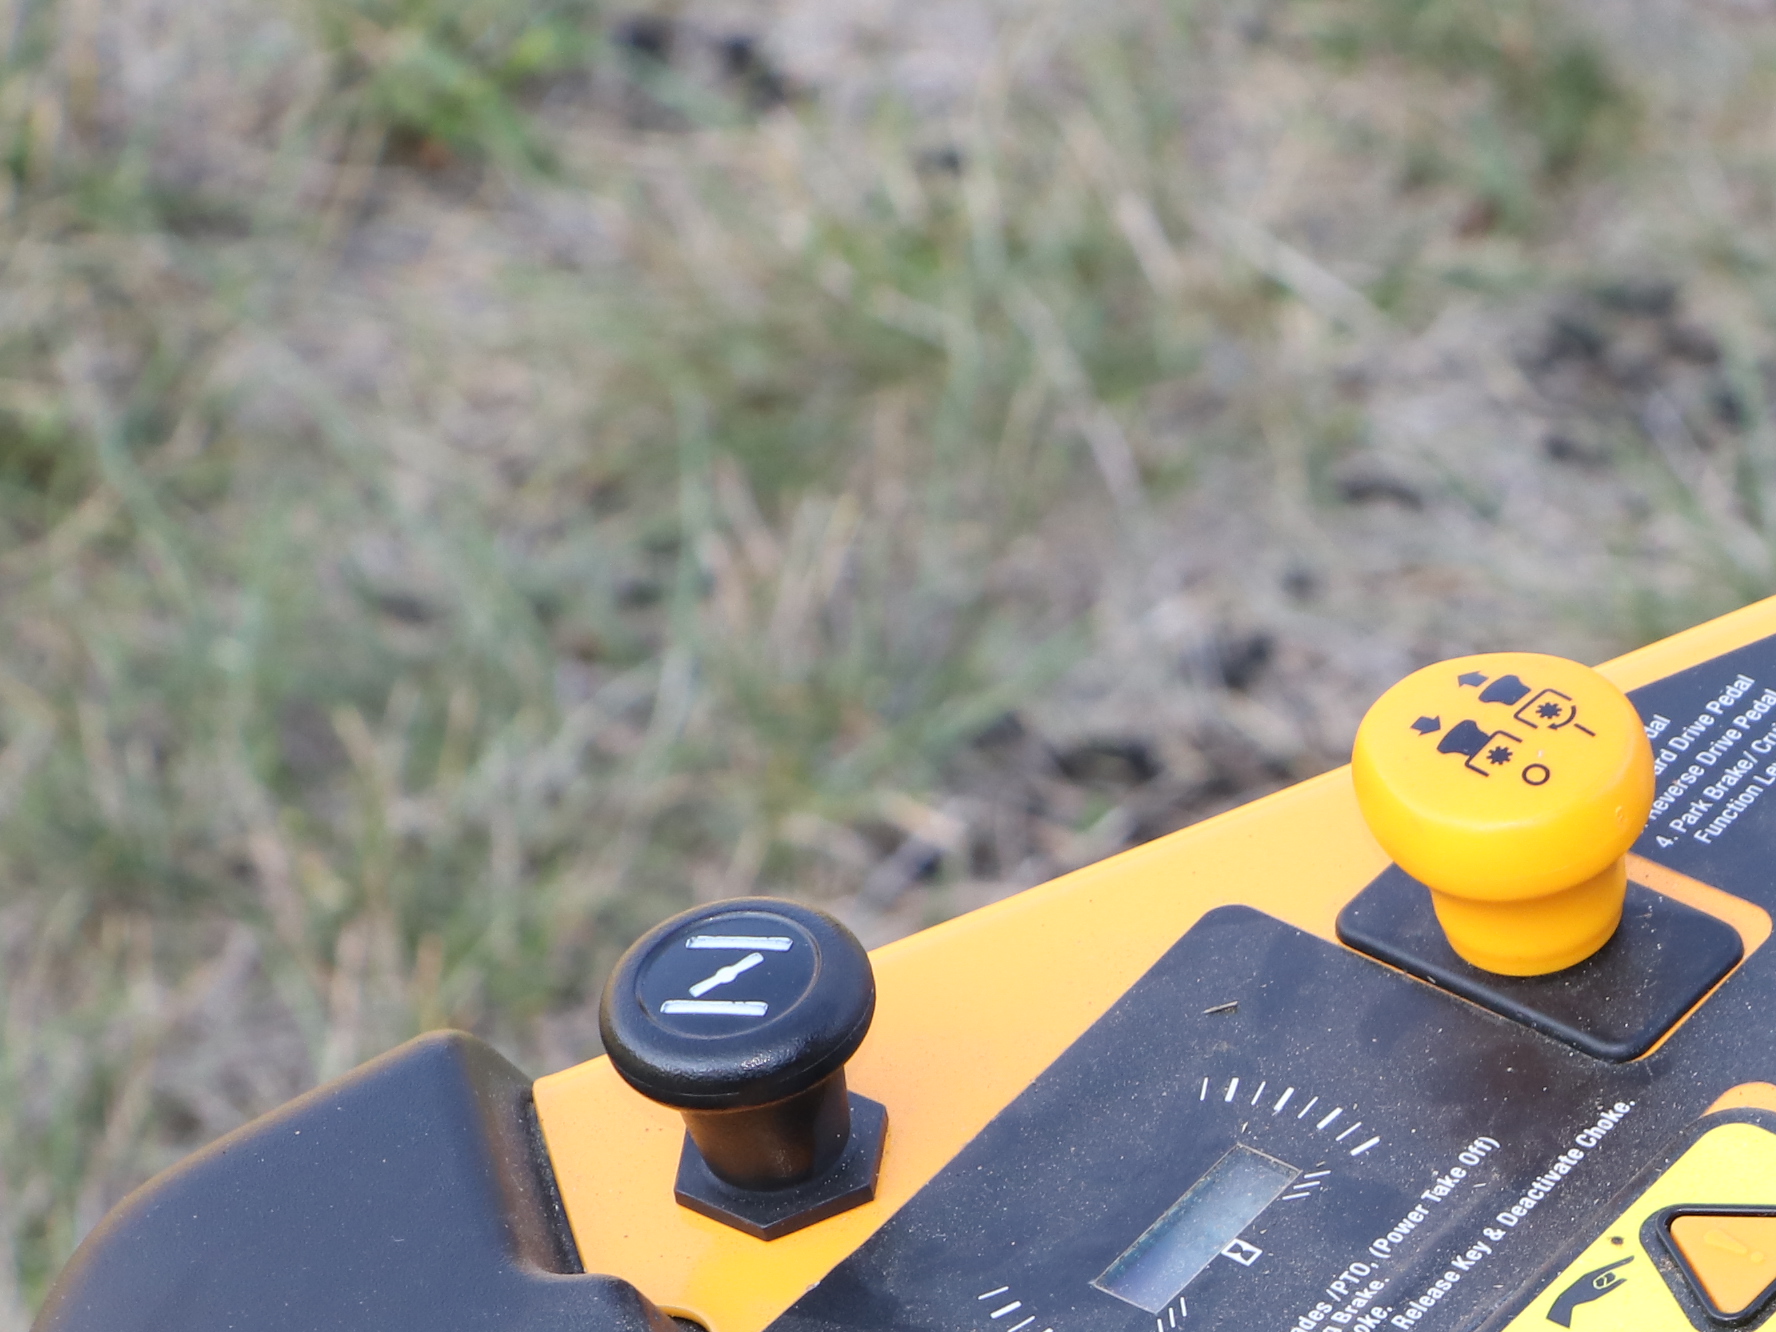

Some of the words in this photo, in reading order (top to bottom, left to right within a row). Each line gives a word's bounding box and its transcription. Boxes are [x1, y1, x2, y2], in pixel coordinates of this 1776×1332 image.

[1644, 713, 1672, 741] dal
[1667, 713, 1716, 753] Drive
[1704, 673, 1756, 716] Pedal
[1694, 728, 1743, 767] Drive
[1668, 798, 1714, 835] Park
[1692, 784, 1765, 845] Function
[1367, 1202, 1431, 1260] (Power
[1419, 1165, 1468, 1203] Take
[1457, 1135, 1501, 1167] Off)
[1389, 1270, 1462, 1331] Release
[1450, 1239, 1493, 1272] Key
[1482, 1226, 1508, 1242] &
[1495, 1147, 1586, 1228] Deactivate
[1574, 1099, 1637, 1149] Choke.
[1329, 1277, 1391, 1325] Brake.
